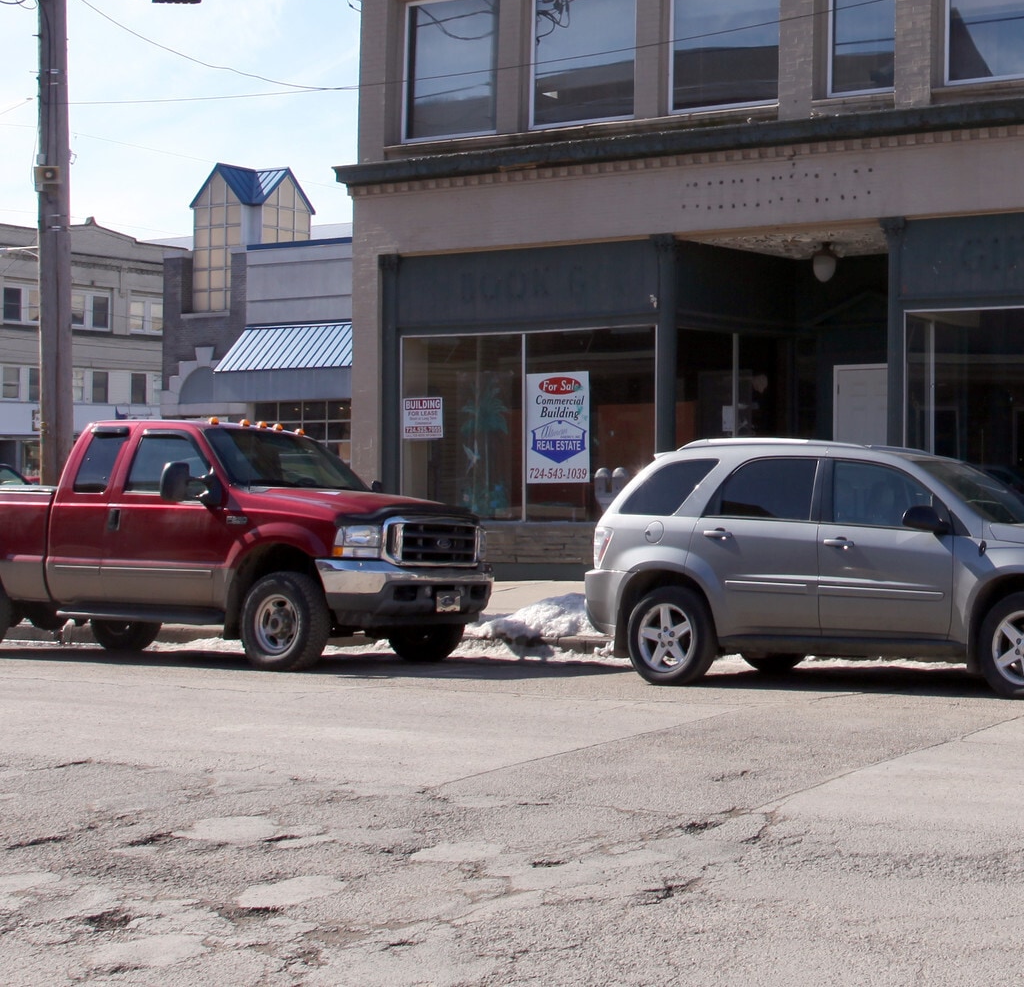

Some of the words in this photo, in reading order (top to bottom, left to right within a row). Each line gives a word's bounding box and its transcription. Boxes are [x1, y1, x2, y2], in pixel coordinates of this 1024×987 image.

[543, 380, 558, 391] For
[405, 399, 441, 410] BUILDING
[536, 395, 585, 406] Commercial
[540, 406, 579, 421] Building
[536, 440, 555, 451] REAL
[555, 440, 582, 451] ESTATE
[529, 467, 588, 480] 724-543-1039
